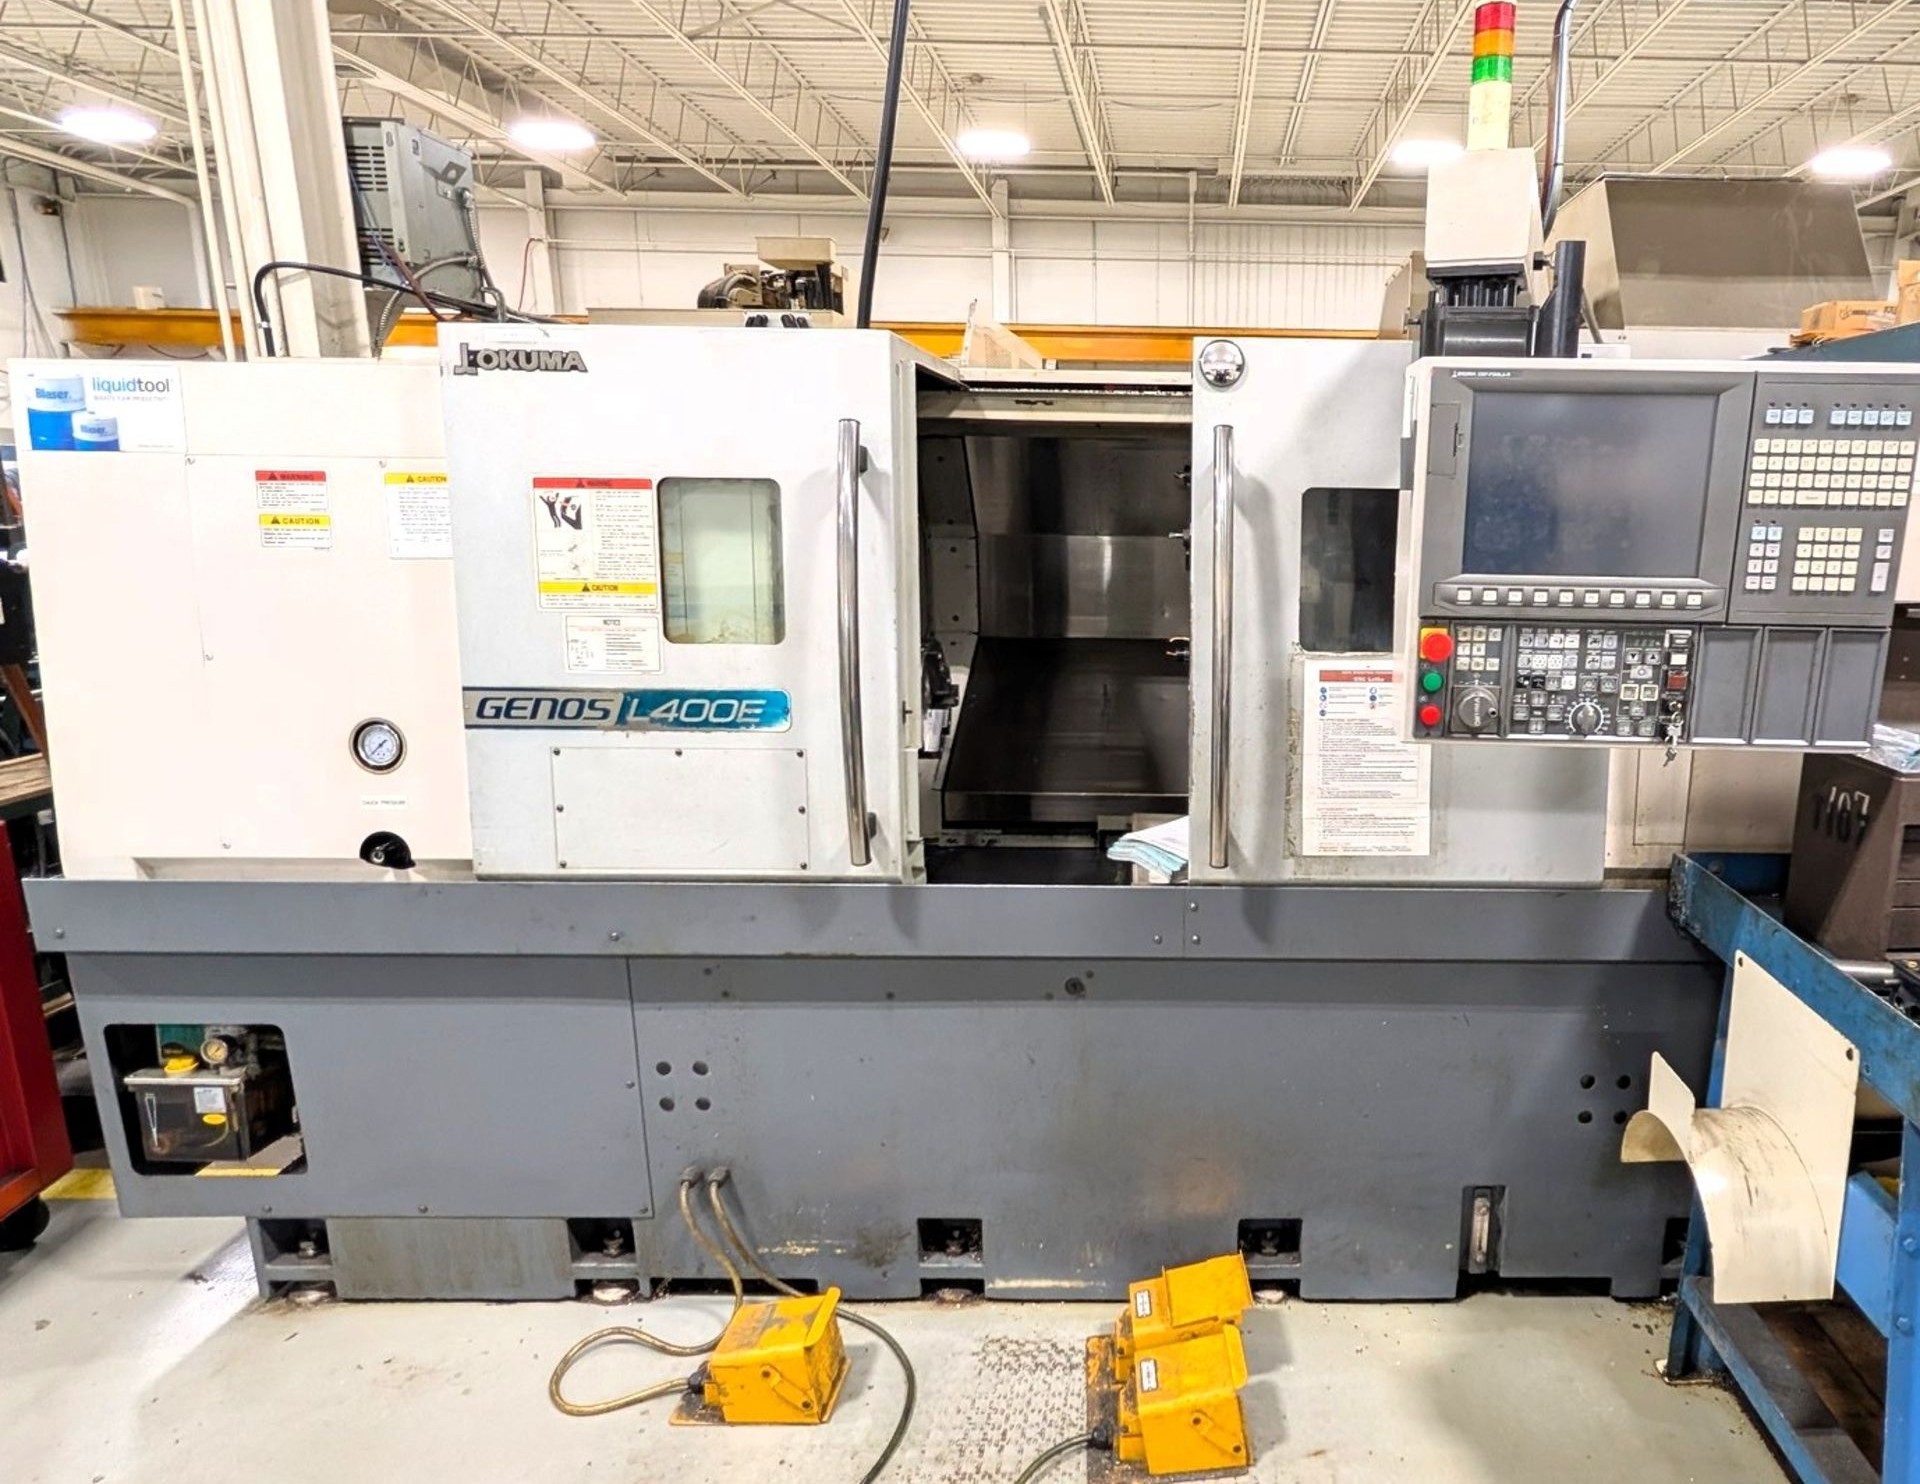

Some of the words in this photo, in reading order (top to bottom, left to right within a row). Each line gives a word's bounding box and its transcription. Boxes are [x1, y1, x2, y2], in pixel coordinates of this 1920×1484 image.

[476, 348, 588, 372] OKUMA
[91, 377, 171, 393] liquidtool
[282, 517, 321, 525] CAUTION
[591, 584, 619, 592] CAUTION
[475, 697, 615, 721] GENOS
[626, 696, 767, 723] L400E
